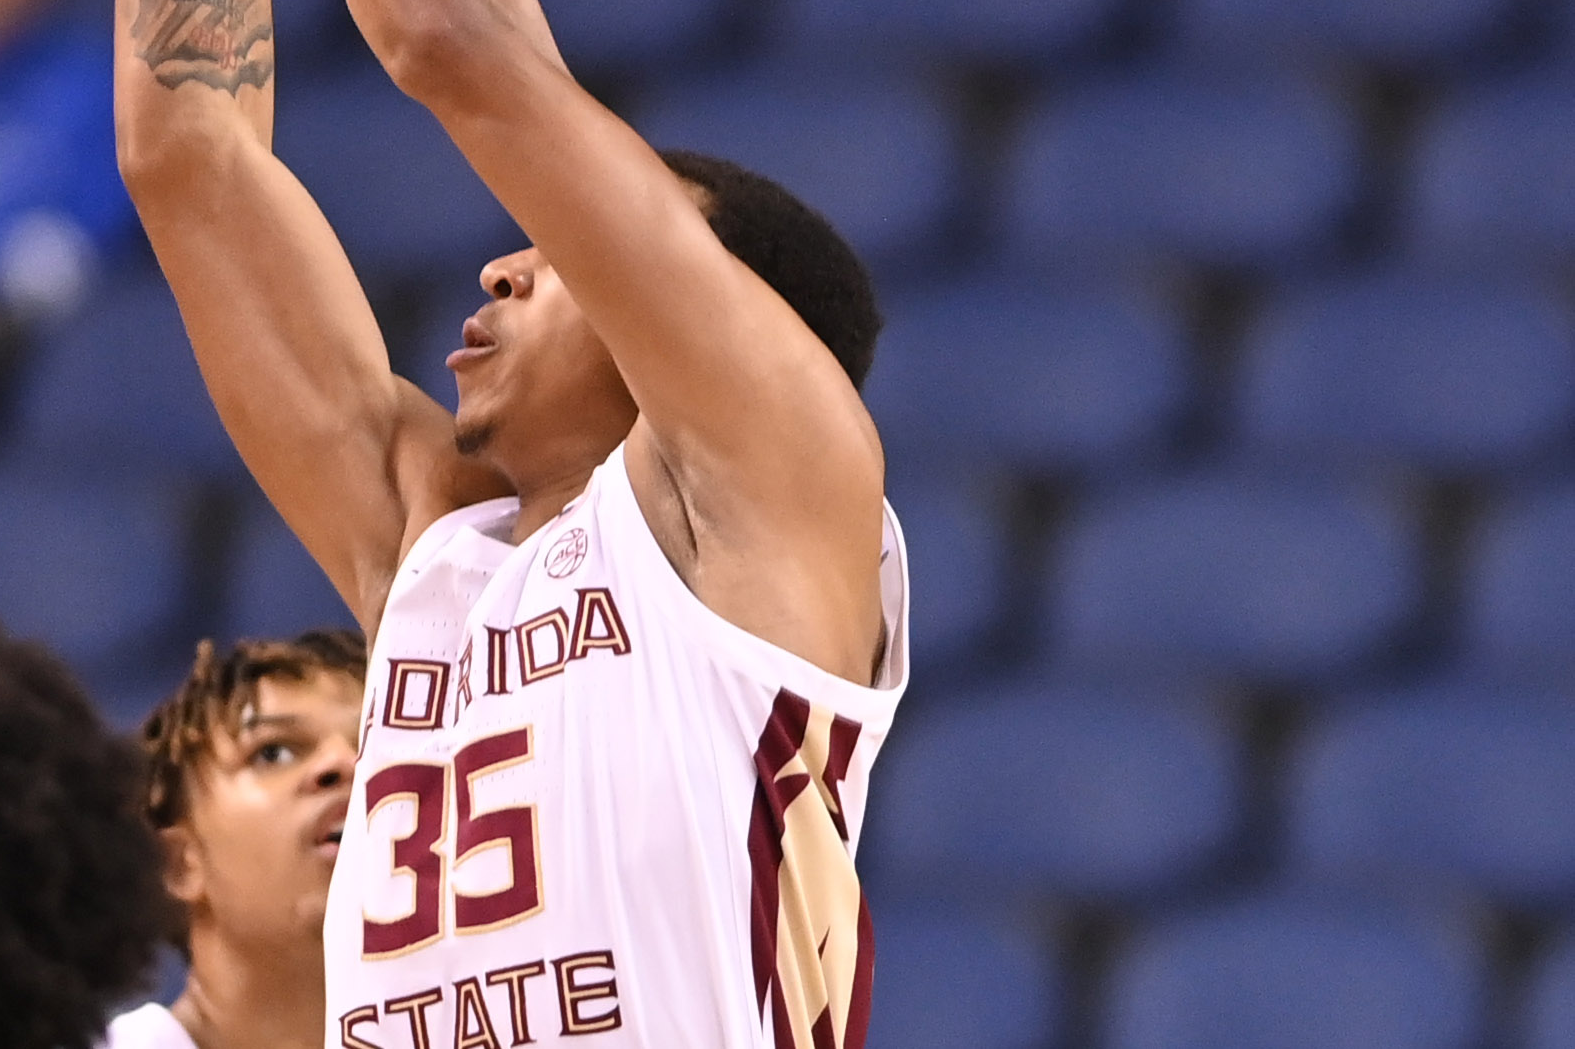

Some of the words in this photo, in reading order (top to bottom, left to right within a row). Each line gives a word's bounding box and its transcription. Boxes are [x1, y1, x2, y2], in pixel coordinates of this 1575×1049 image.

[355, 587, 632, 763] ORIDA
[360, 723, 545, 963] 35
[339, 949, 623, 1049] STATE
